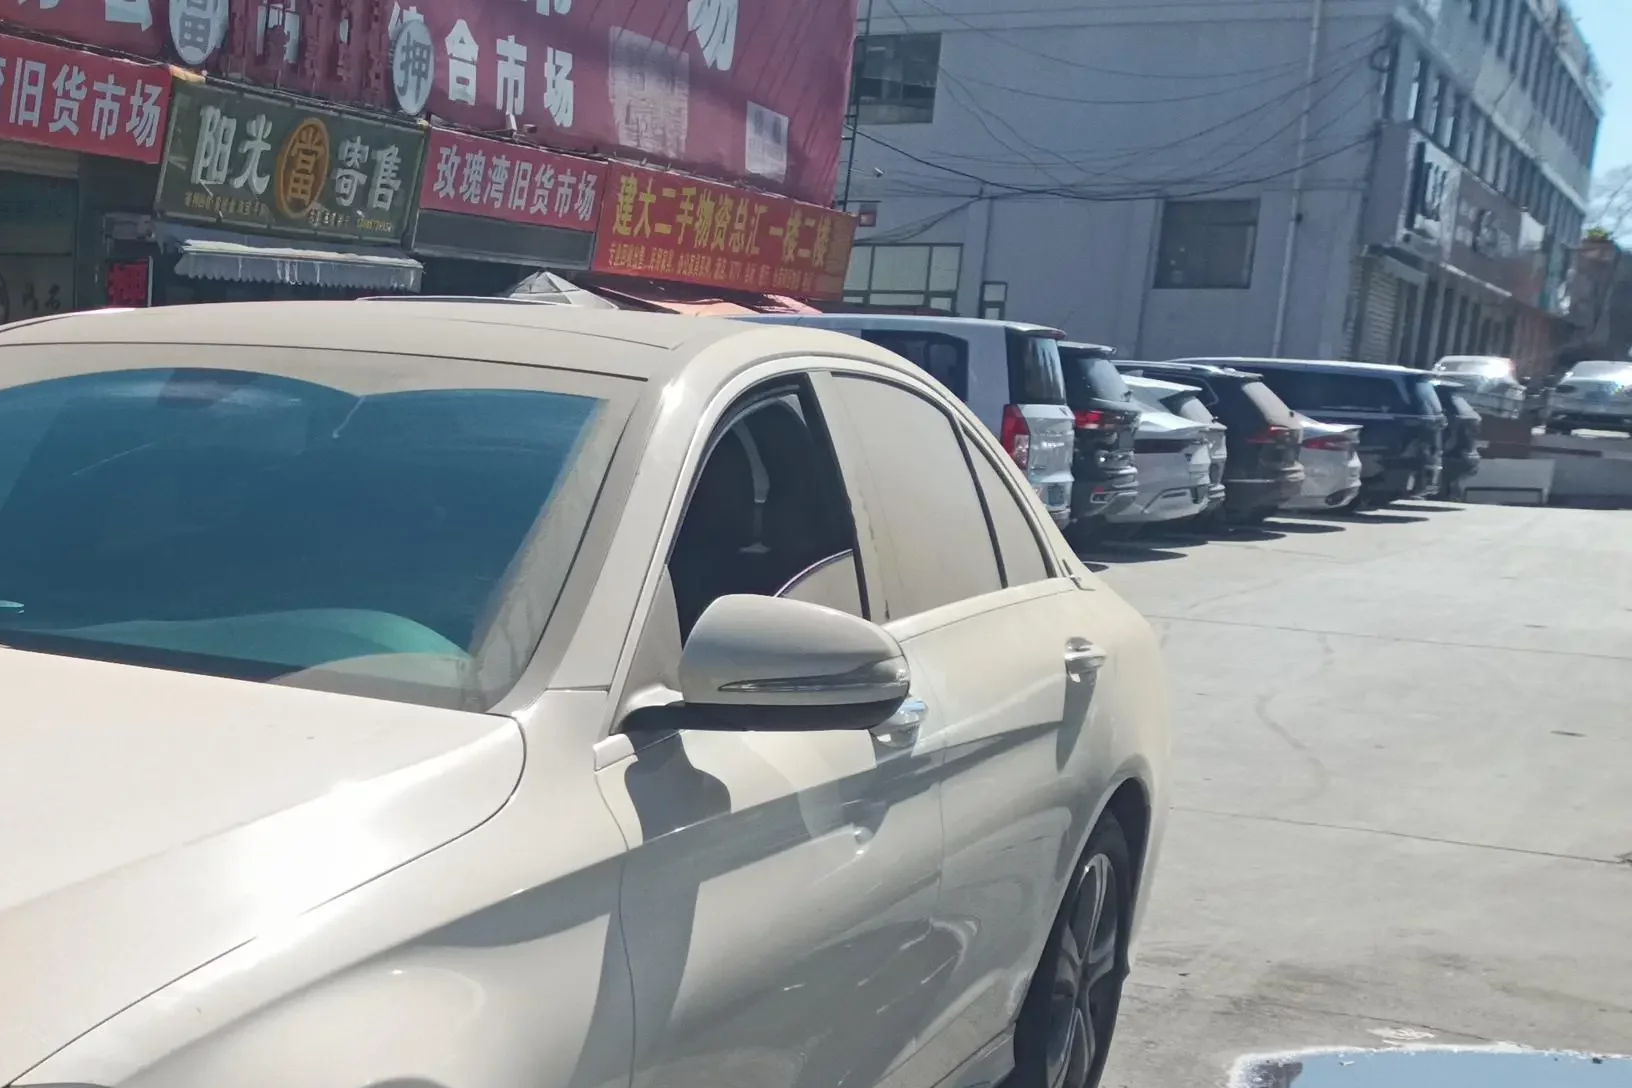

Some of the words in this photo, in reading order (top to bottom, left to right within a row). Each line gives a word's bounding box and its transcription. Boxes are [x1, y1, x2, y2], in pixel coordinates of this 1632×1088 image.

[389, 1, 574, 128] 合市场
[396, 30, 432, 104] 押
[190, 104, 272, 196] 阳光
[331, 136, 405, 212] 寄售
[433, 144, 597, 222] 玫瑰湾旧货市场
